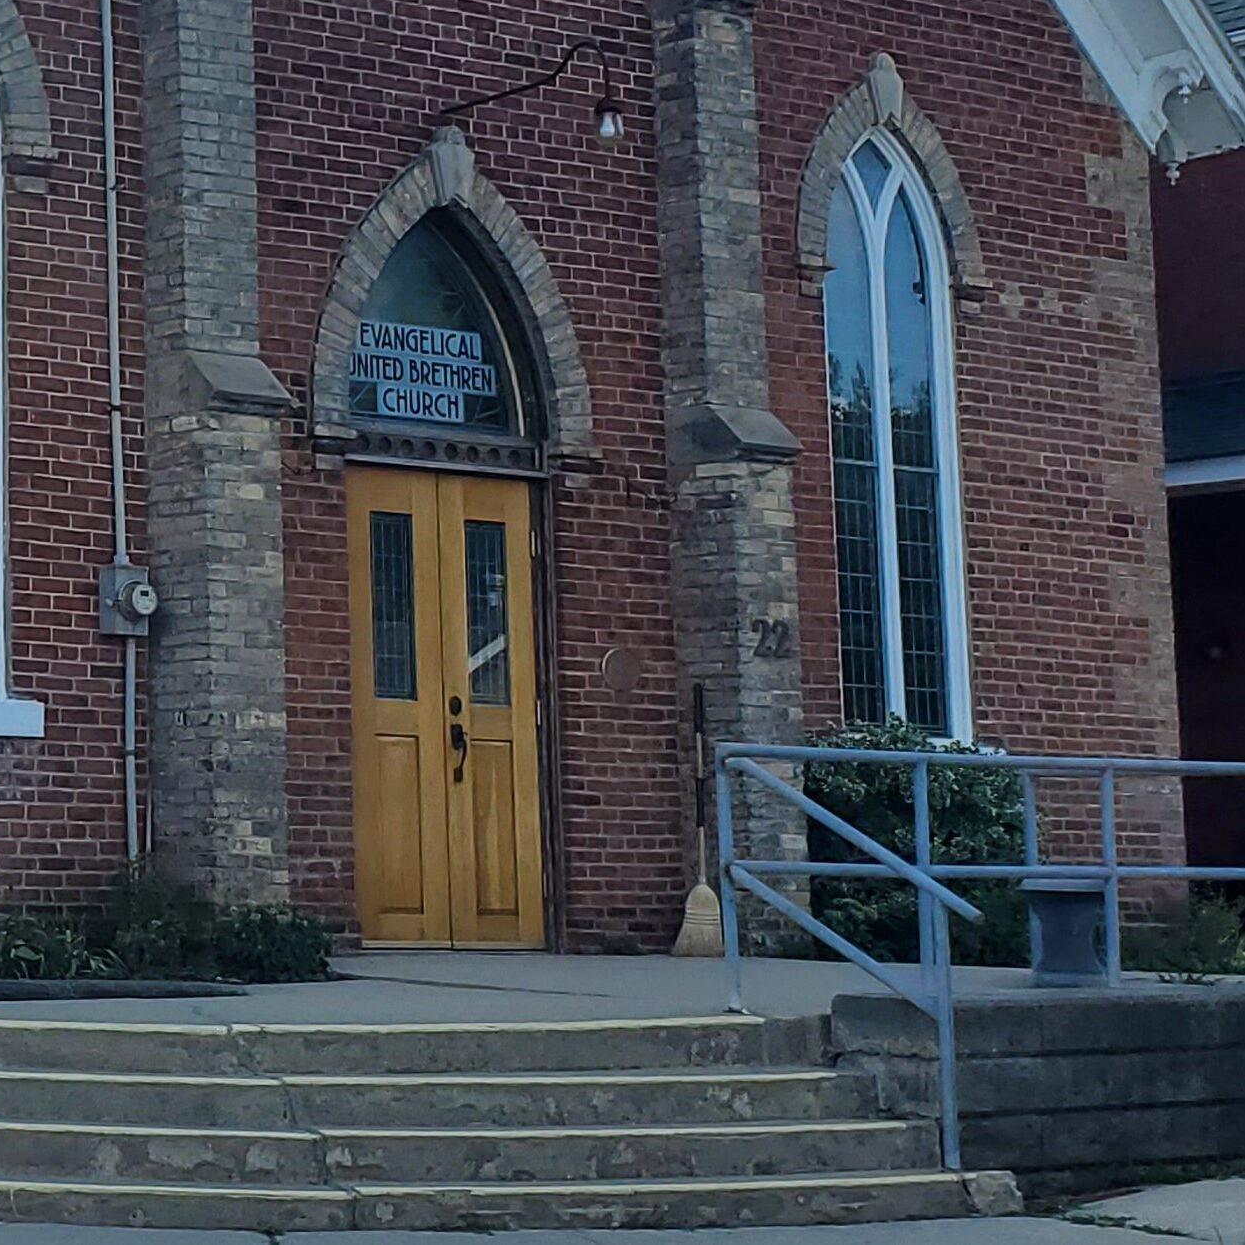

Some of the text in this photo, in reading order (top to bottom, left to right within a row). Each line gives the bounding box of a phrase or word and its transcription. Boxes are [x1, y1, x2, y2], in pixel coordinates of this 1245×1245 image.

[360, 322, 480, 361] EVANGELICAL
[349, 352, 493, 392] UNITED BRETHREN
[382, 387, 459, 419] CHURCH
[751, 619, 788, 658] 22
